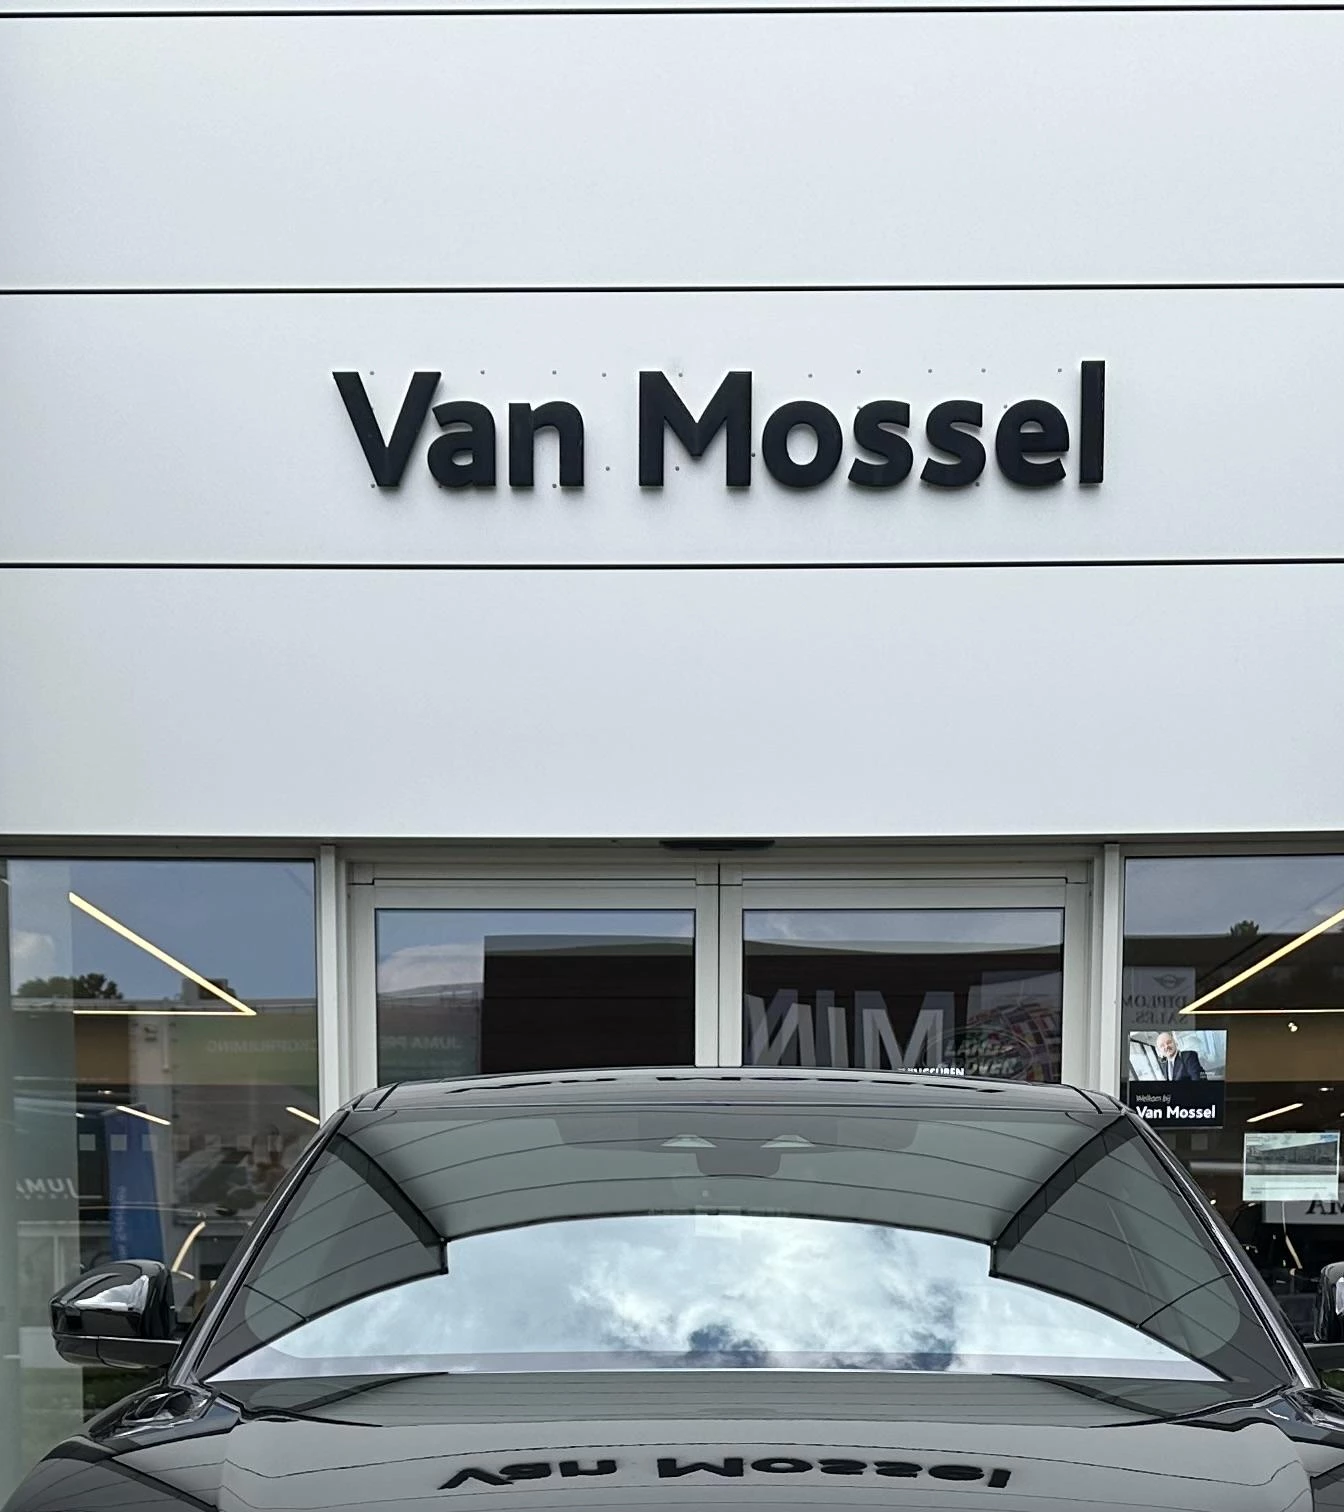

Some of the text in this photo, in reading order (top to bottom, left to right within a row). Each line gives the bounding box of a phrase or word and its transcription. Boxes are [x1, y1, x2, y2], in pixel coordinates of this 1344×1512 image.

[332, 360, 1106, 487] Van Mossel
[1136, 1105, 1216, 1119] Van Mossel
